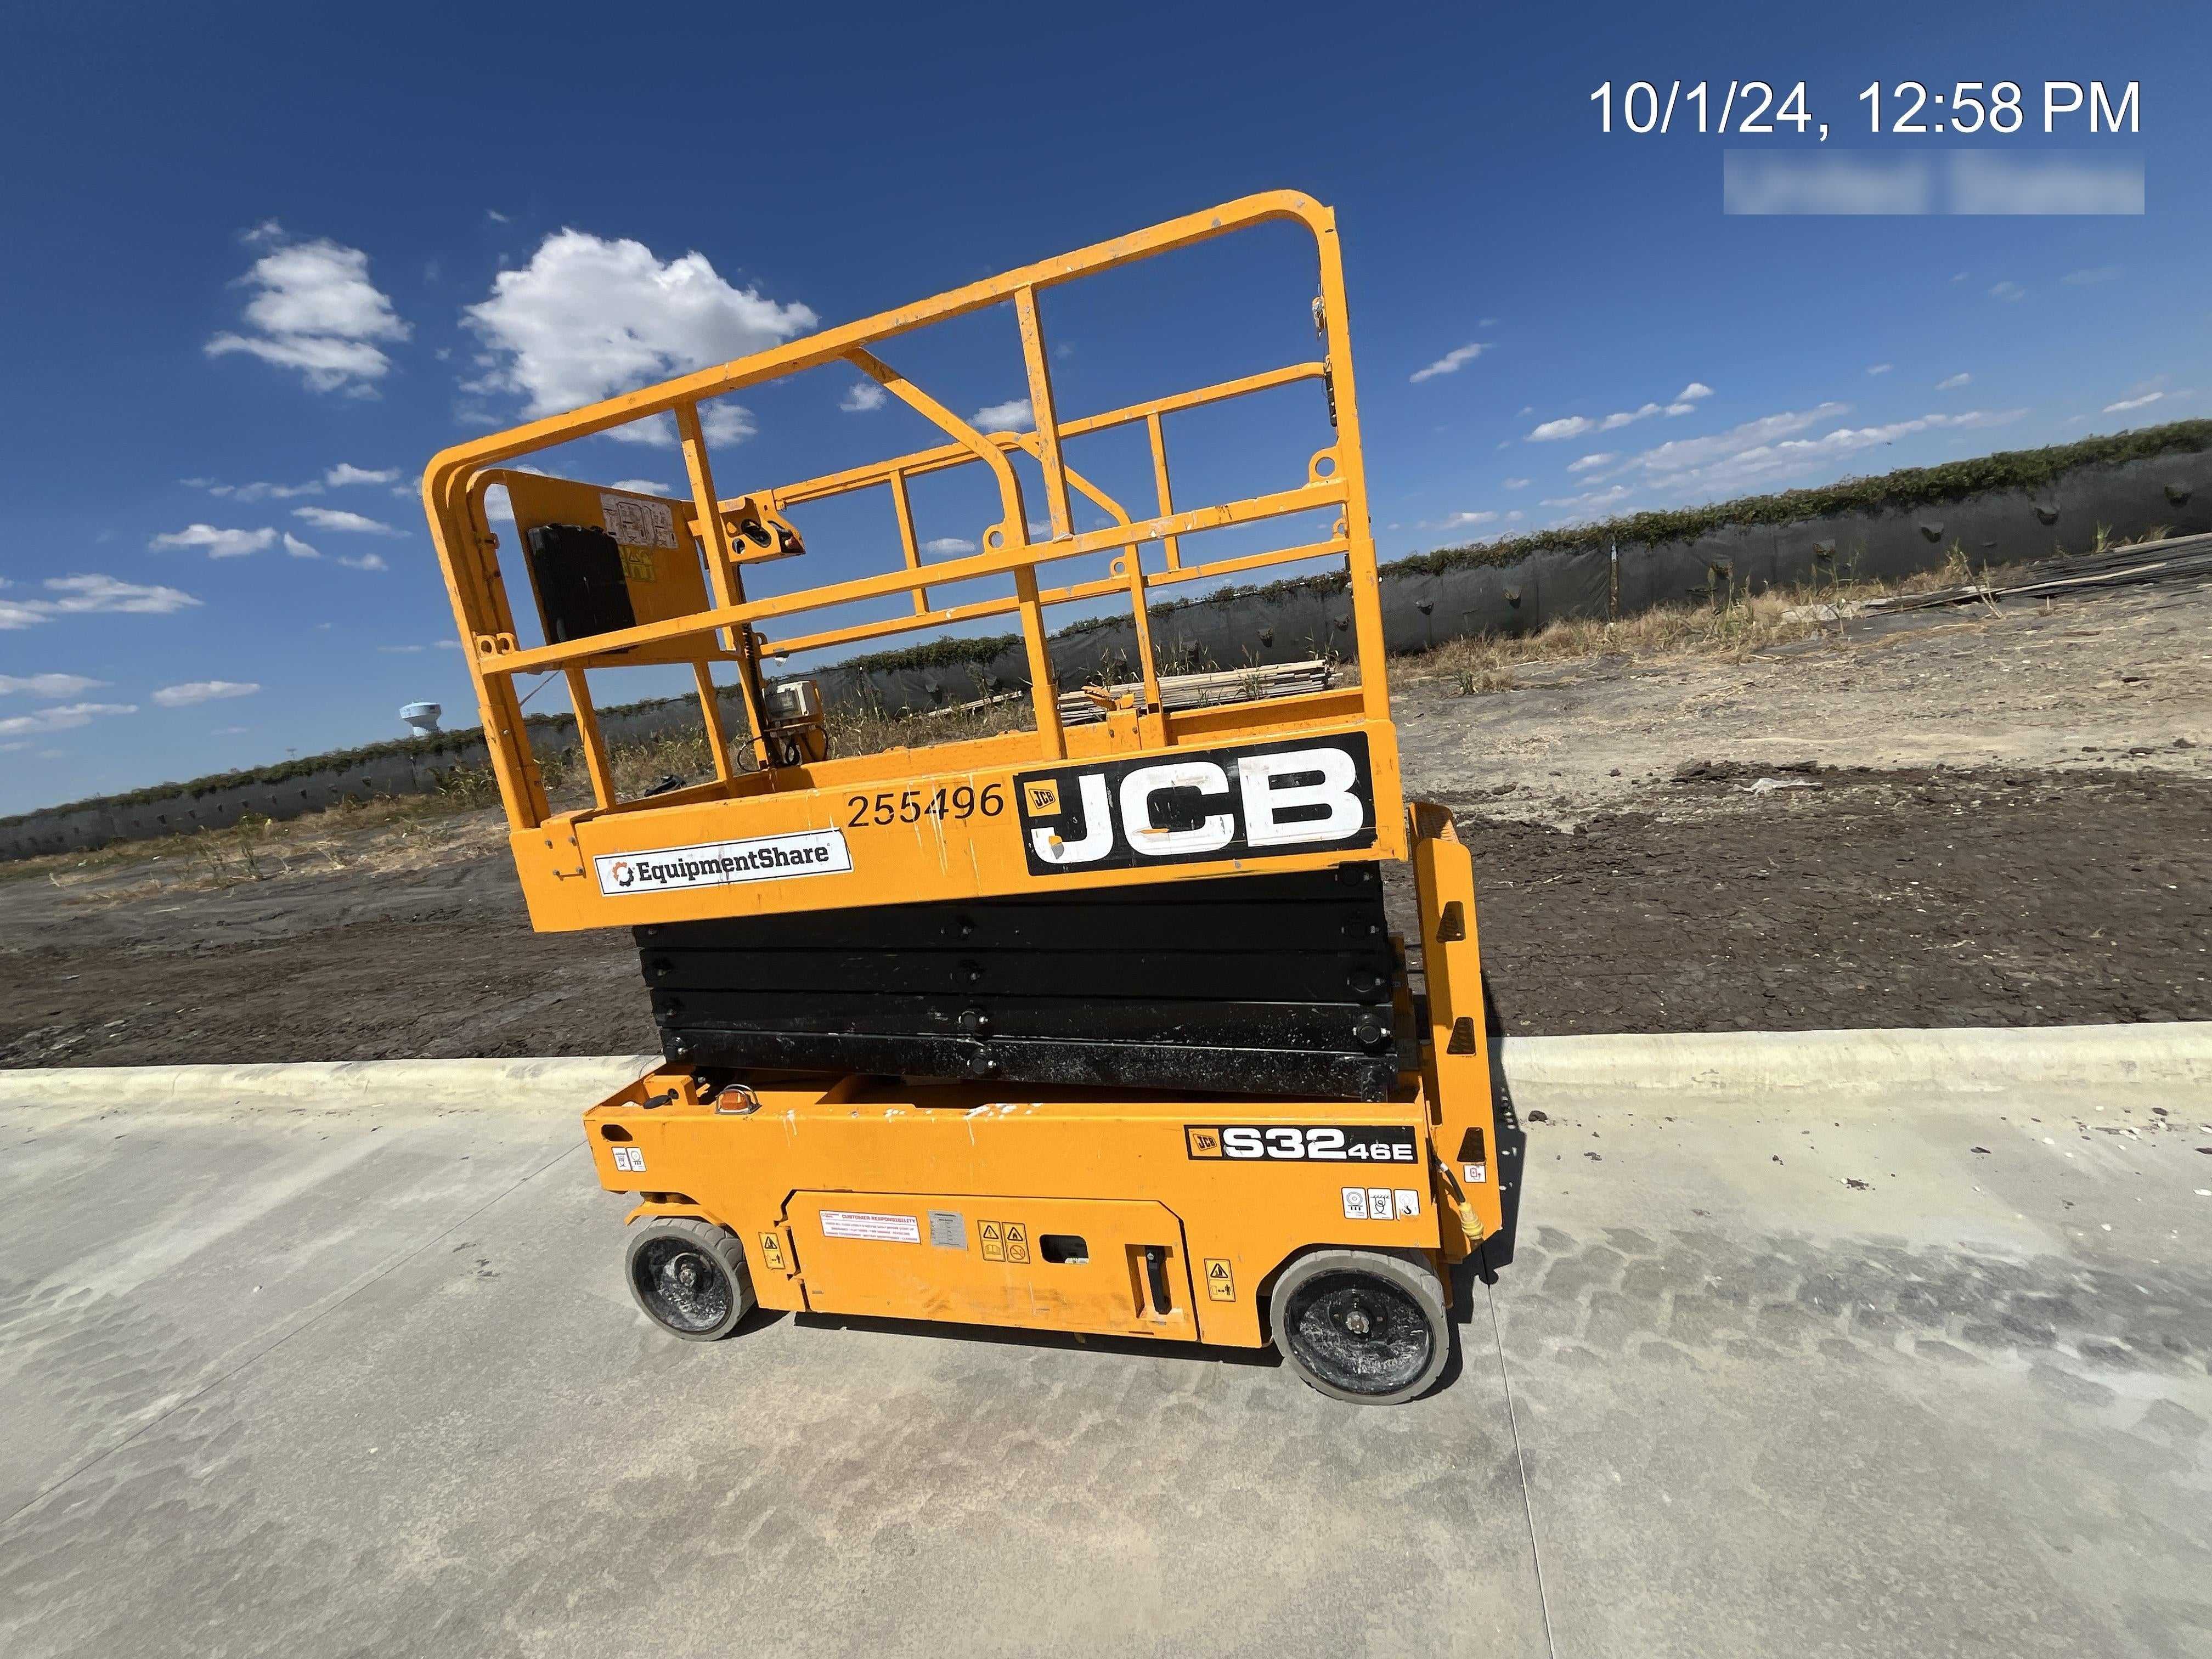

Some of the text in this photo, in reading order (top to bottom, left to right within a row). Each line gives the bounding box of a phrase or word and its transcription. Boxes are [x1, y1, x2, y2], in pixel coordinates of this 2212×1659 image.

[848, 783, 1004, 827] 255496
[1031, 747, 1363, 864] JCB
[1033, 791, 1054, 807] JCB
[636, 846, 830, 884] EquipmentShare
[1197, 1136, 1216, 1149] JCB
